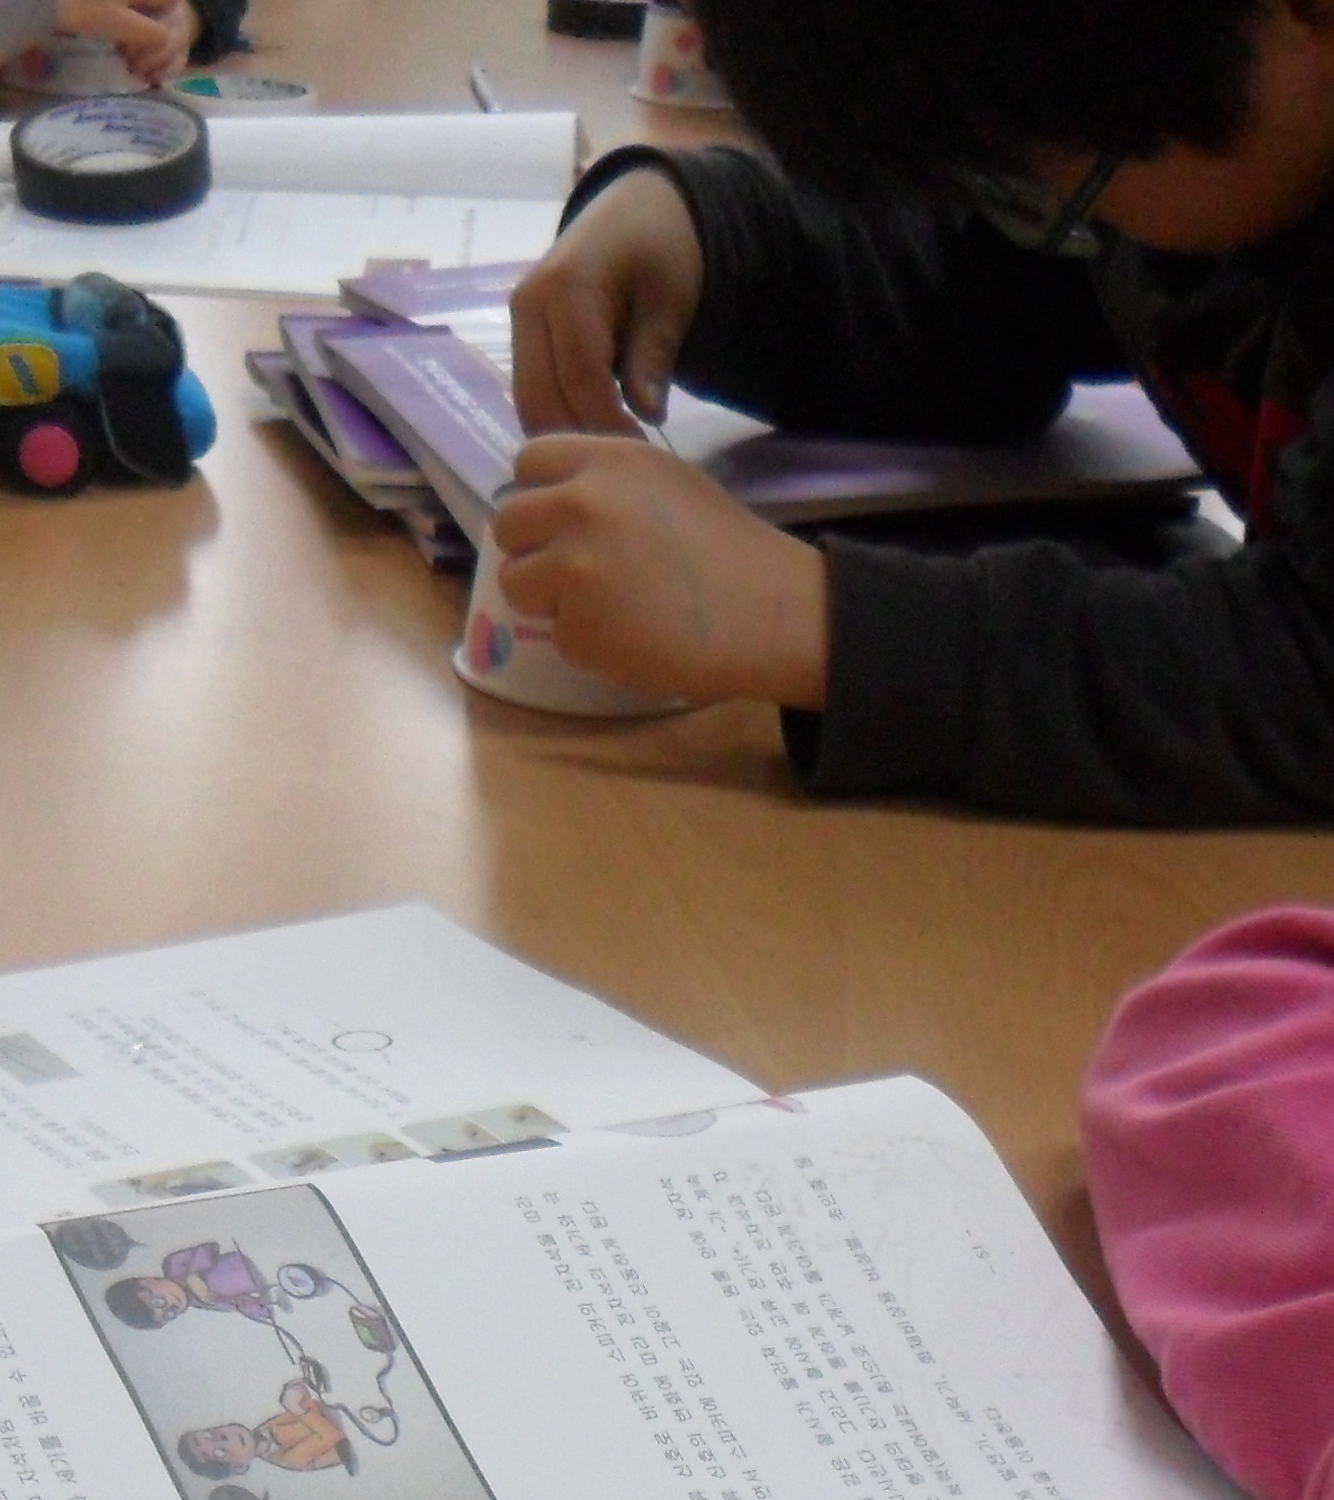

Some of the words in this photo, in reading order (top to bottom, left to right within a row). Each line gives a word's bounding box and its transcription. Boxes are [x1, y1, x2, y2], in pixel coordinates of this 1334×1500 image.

[512, 1194, 542, 1224] 따라
[534, 1232, 584, 1292] 전자석을
[576, 1301, 627, 1363] 스피커의
[652, 1429, 693, 1478] 신호로
